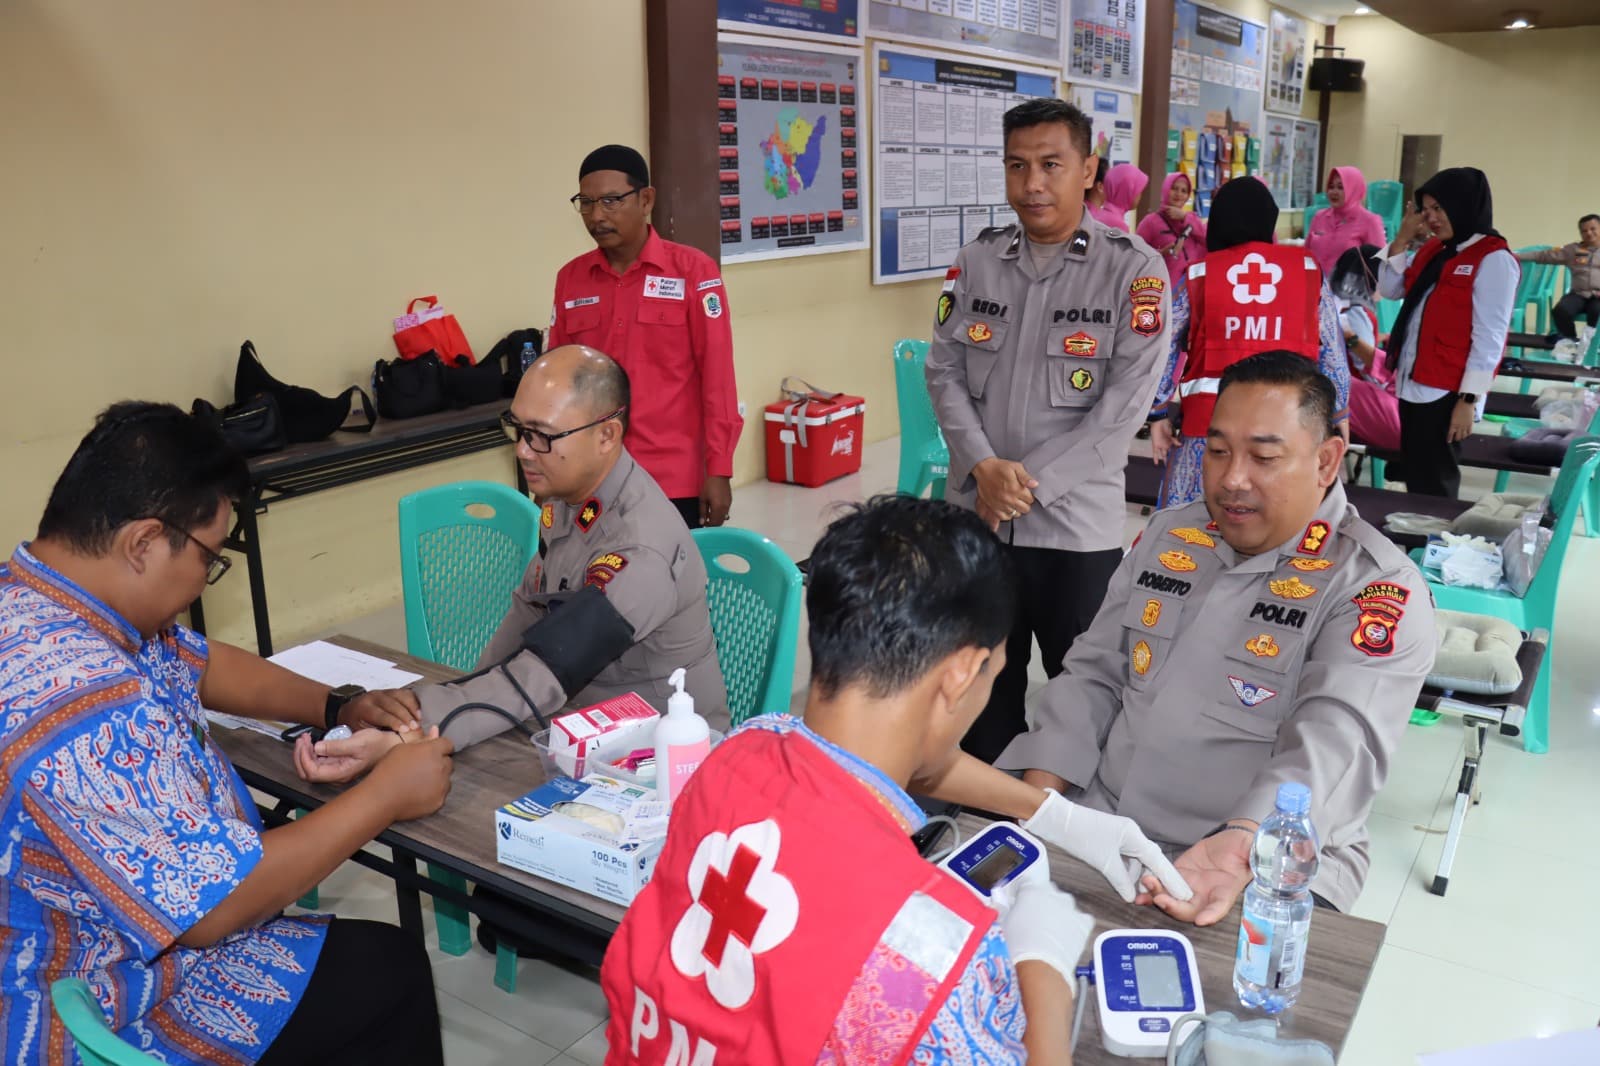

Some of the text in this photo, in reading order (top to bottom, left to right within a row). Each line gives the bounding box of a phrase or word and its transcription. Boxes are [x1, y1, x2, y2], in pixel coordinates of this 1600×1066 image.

[1053, 309, 1112, 324] POLRI
[1225, 316, 1282, 341] PMI
[1137, 570, 1192, 596] ROBERTO
[1360, 584, 1399, 595] POLRES
[1386, 591, 1405, 601] HULU
[1249, 602, 1308, 629] POLRI
[513, 827, 545, 847] Remedi
[592, 850, 627, 868] 100 Pcs
